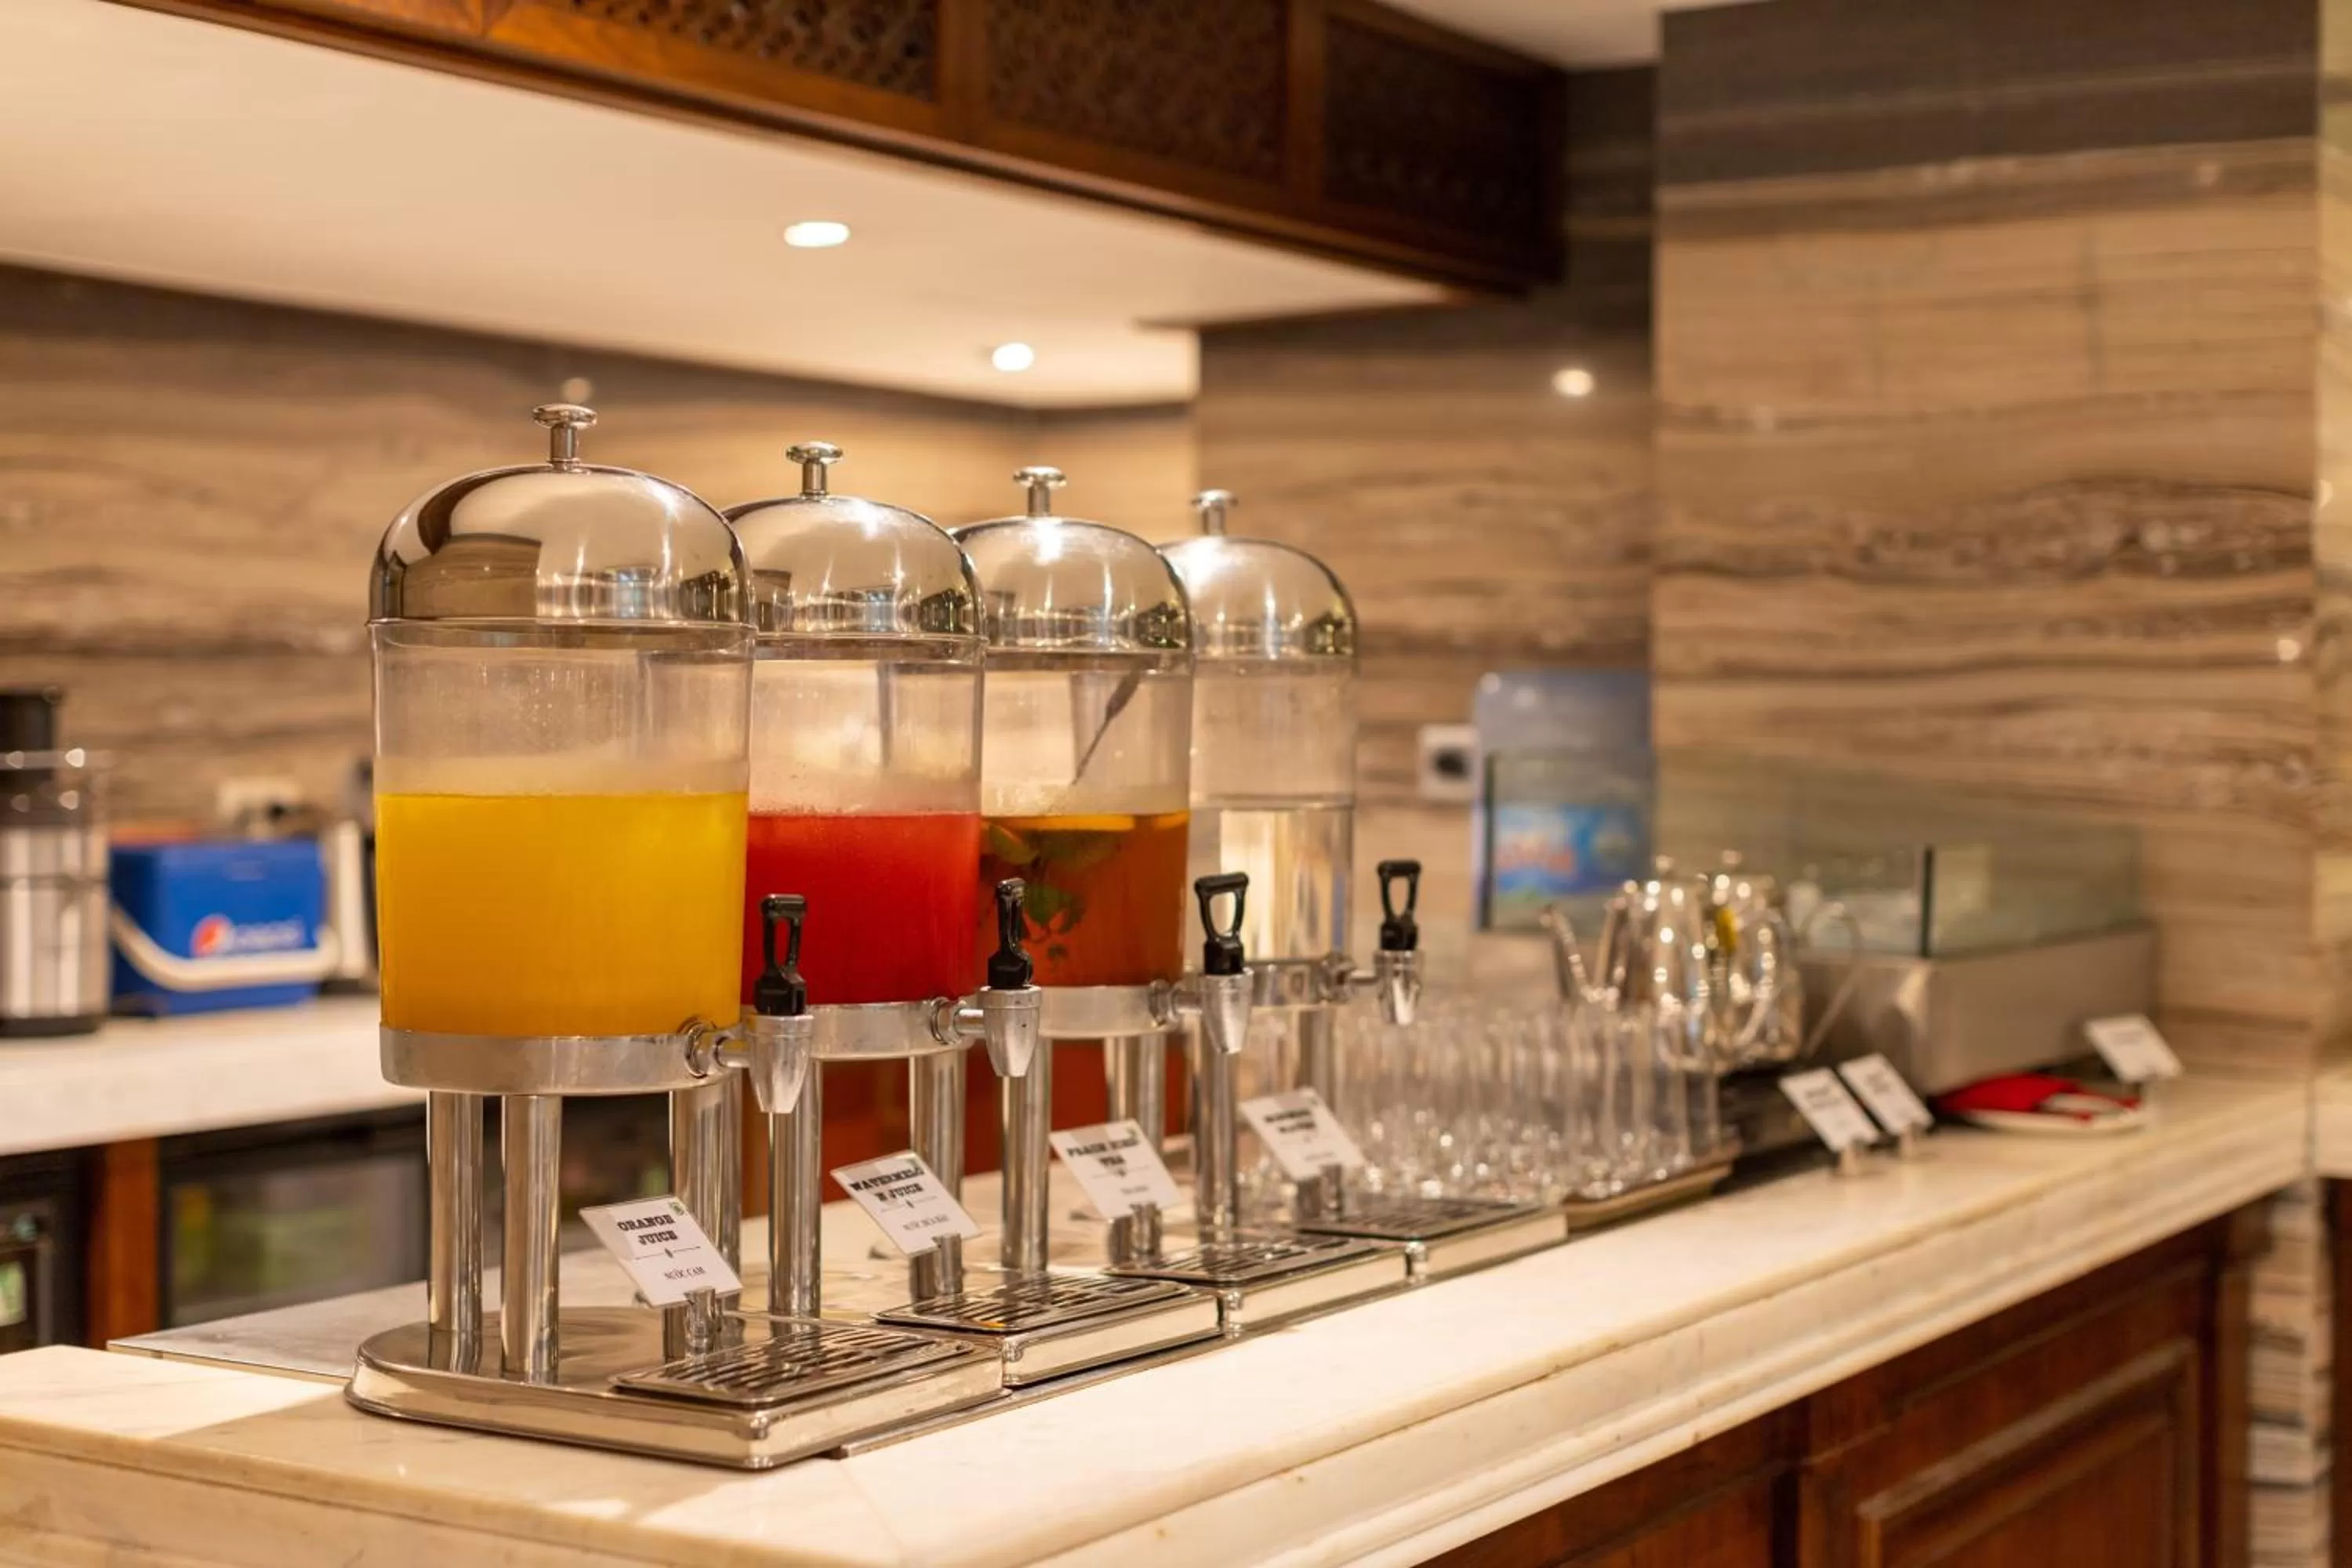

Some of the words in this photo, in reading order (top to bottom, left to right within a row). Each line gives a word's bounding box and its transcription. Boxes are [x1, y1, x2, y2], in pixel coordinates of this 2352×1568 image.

[888, 1182, 924, 1199] JUICE
[617, 1214, 675, 1231] ORANGE
[637, 1229, 679, 1246] JUICE
